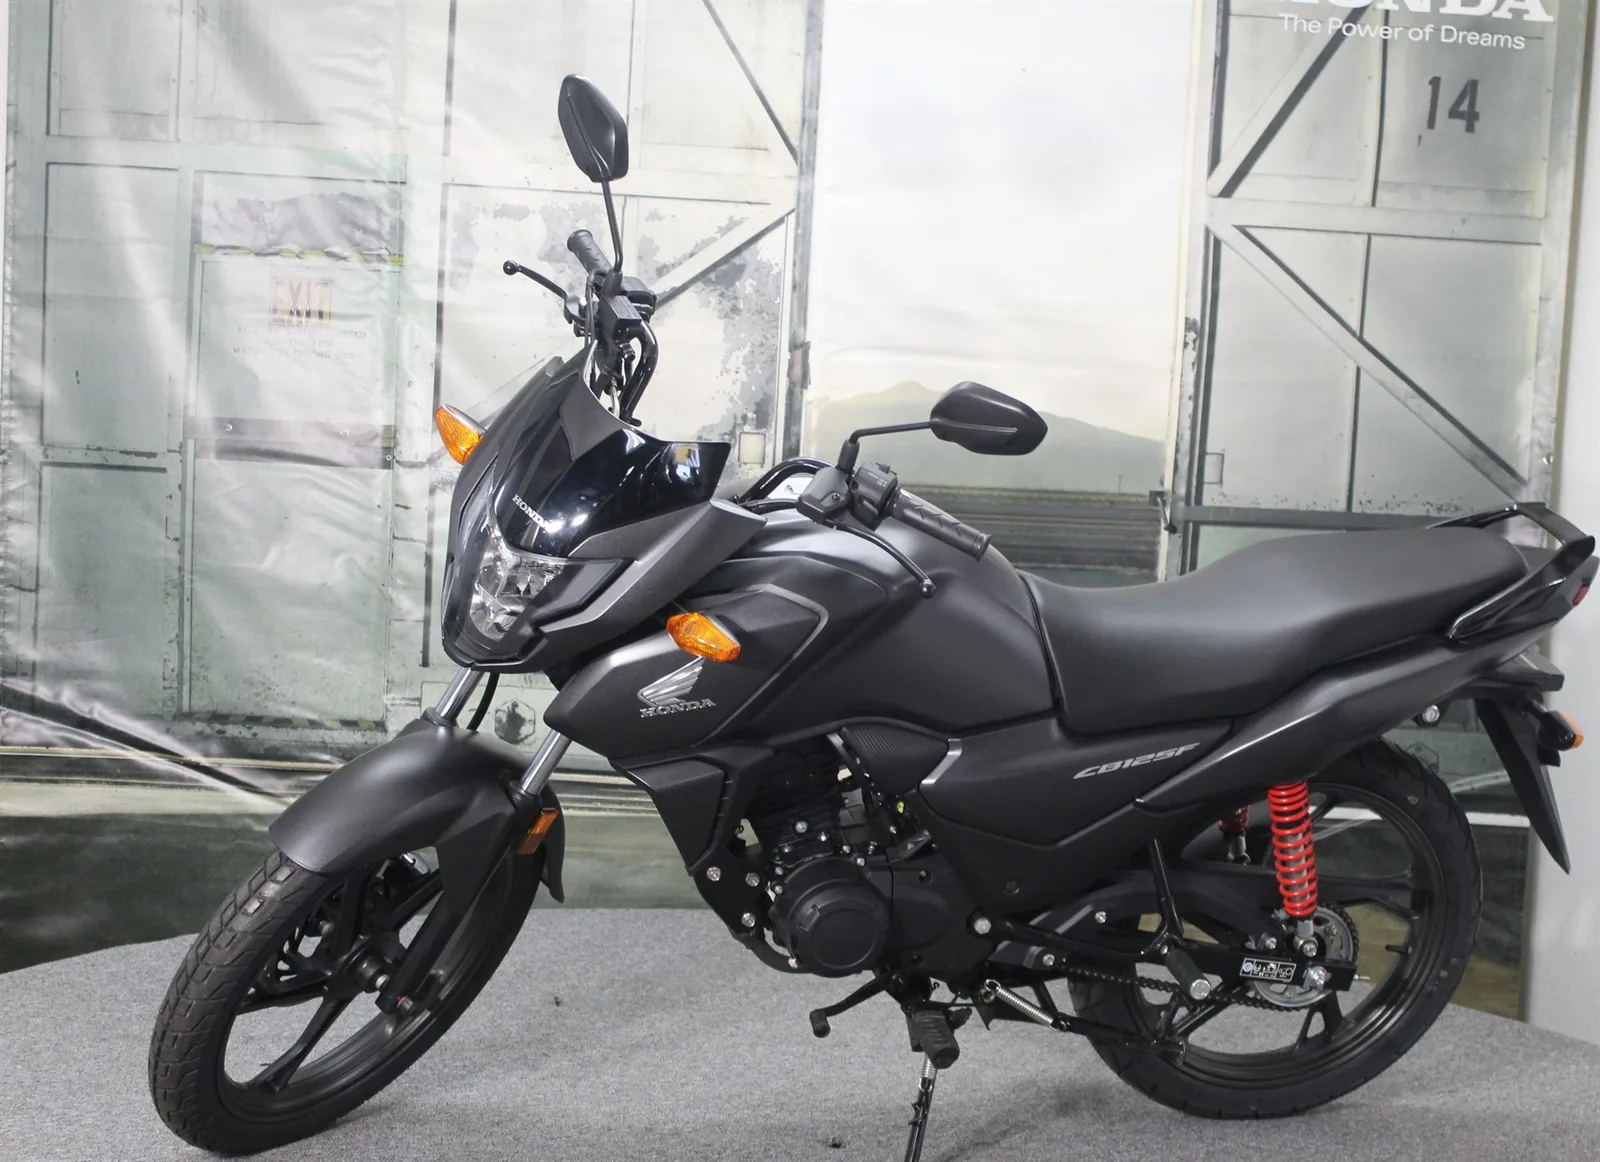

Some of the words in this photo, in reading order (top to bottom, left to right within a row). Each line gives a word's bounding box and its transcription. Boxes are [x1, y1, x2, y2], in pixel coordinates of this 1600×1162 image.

[1278, 13, 1321, 34] The
[1328, 17, 1404, 40] Power
[1408, 24, 1434, 42] of
[1440, 25, 1525, 50] Dreams
[1427, 76, 1480, 133] 14
[640, 698, 717, 718] HONDA
[1073, 742, 1201, 779] CB125F
